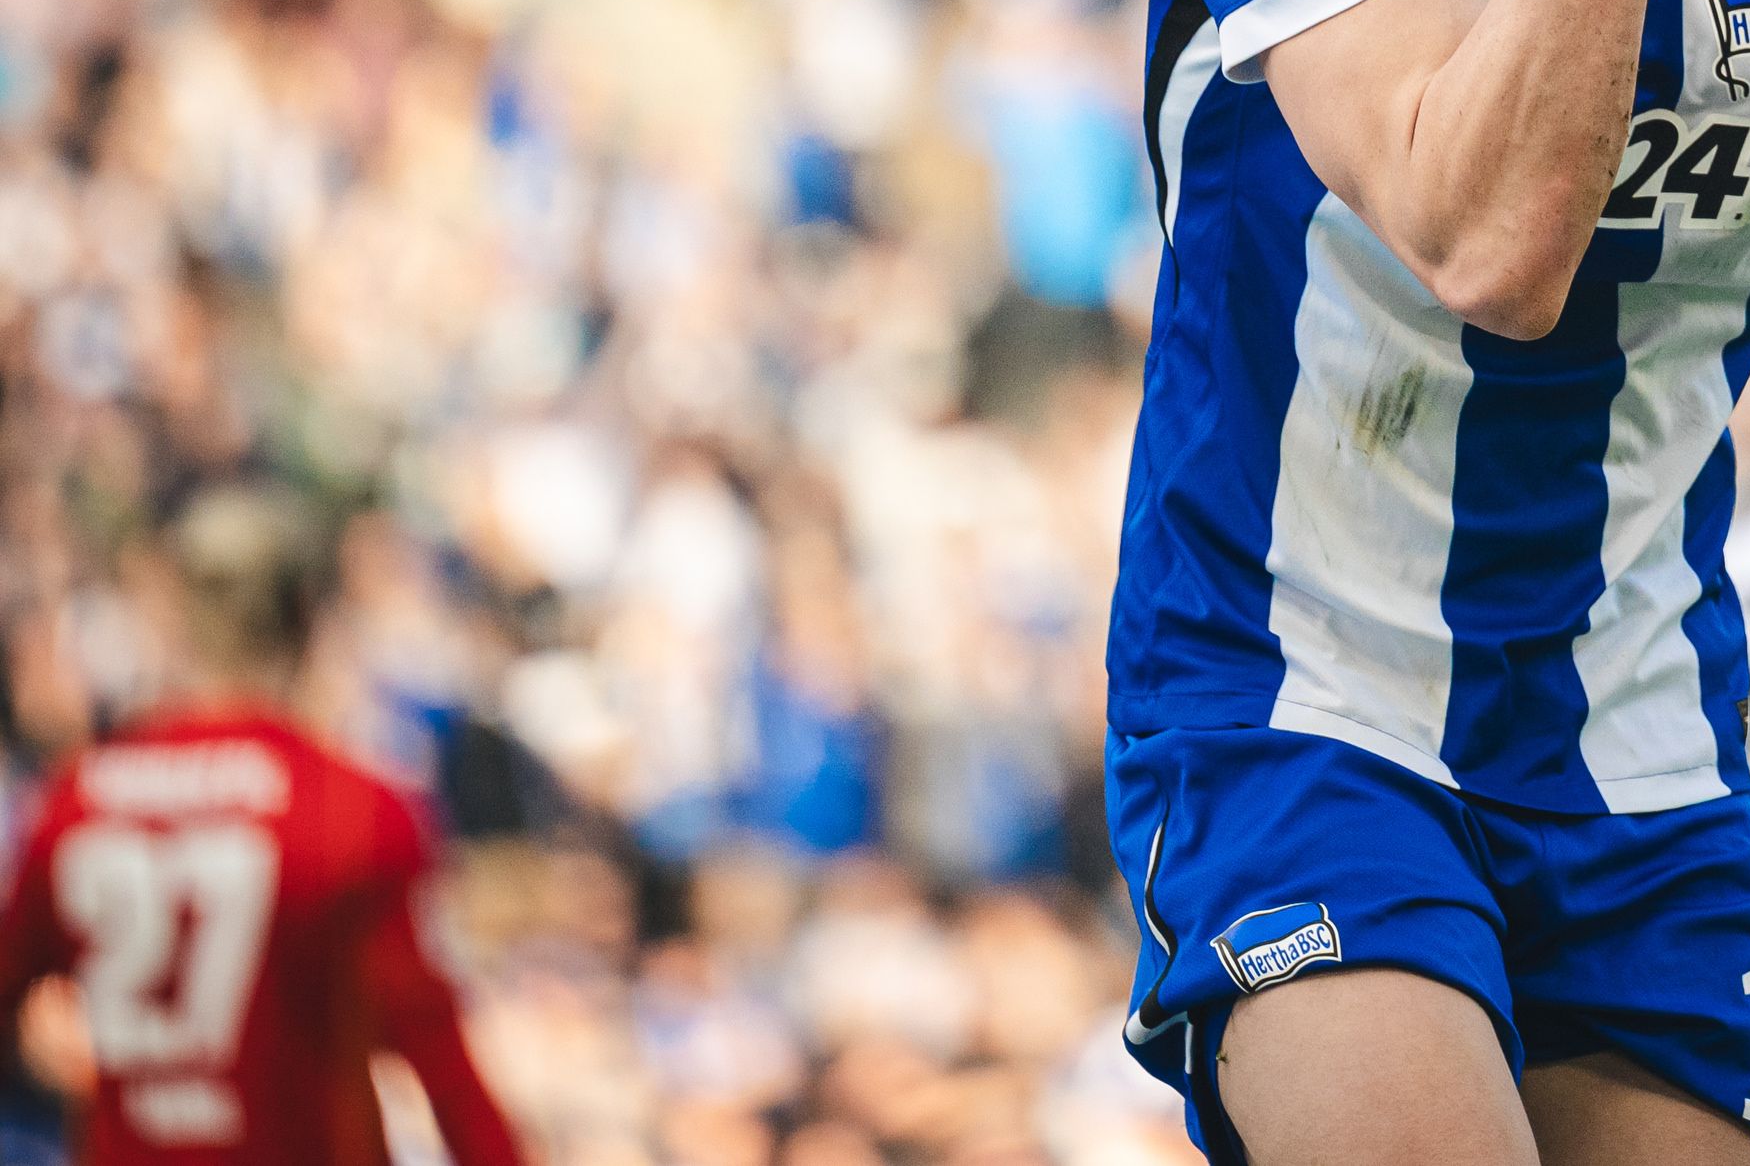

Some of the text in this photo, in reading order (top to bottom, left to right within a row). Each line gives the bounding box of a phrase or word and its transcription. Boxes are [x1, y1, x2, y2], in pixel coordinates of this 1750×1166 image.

[50, 823, 282, 1067] 27
[1241, 925, 1331, 981] Hertha BSC
